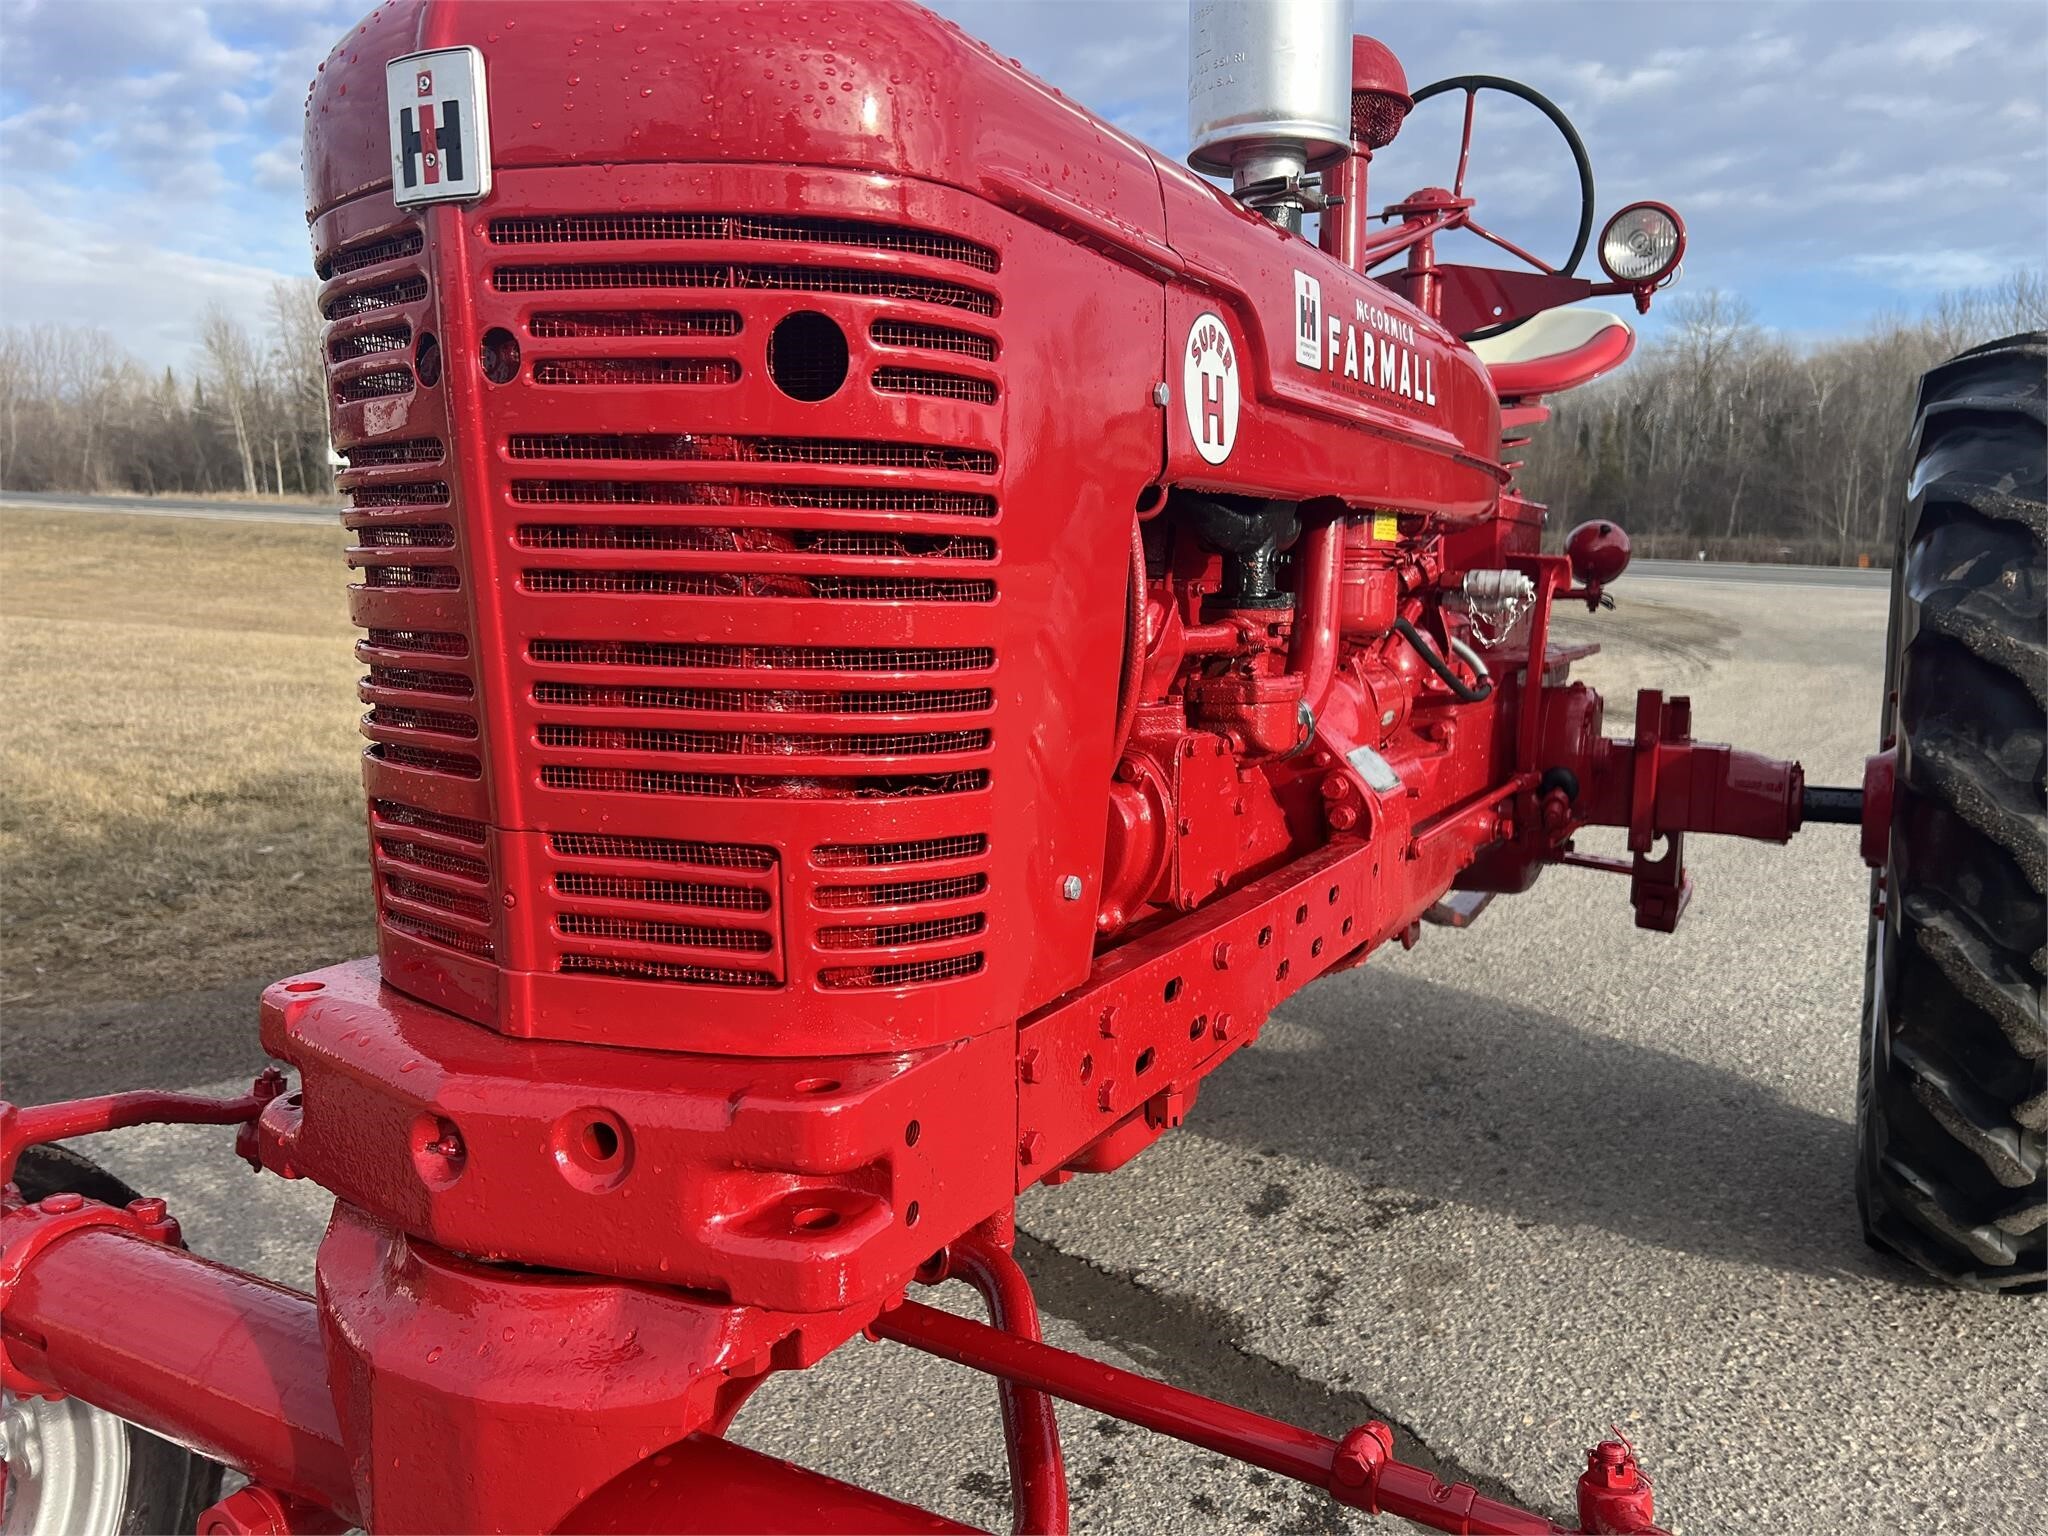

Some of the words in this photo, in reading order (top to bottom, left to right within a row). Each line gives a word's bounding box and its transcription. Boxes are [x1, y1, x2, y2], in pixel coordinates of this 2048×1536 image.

[1191, 324, 1232, 376] SUPER
[1328, 315, 1436, 406] FARMALL
[1201, 372, 1225, 446] H
